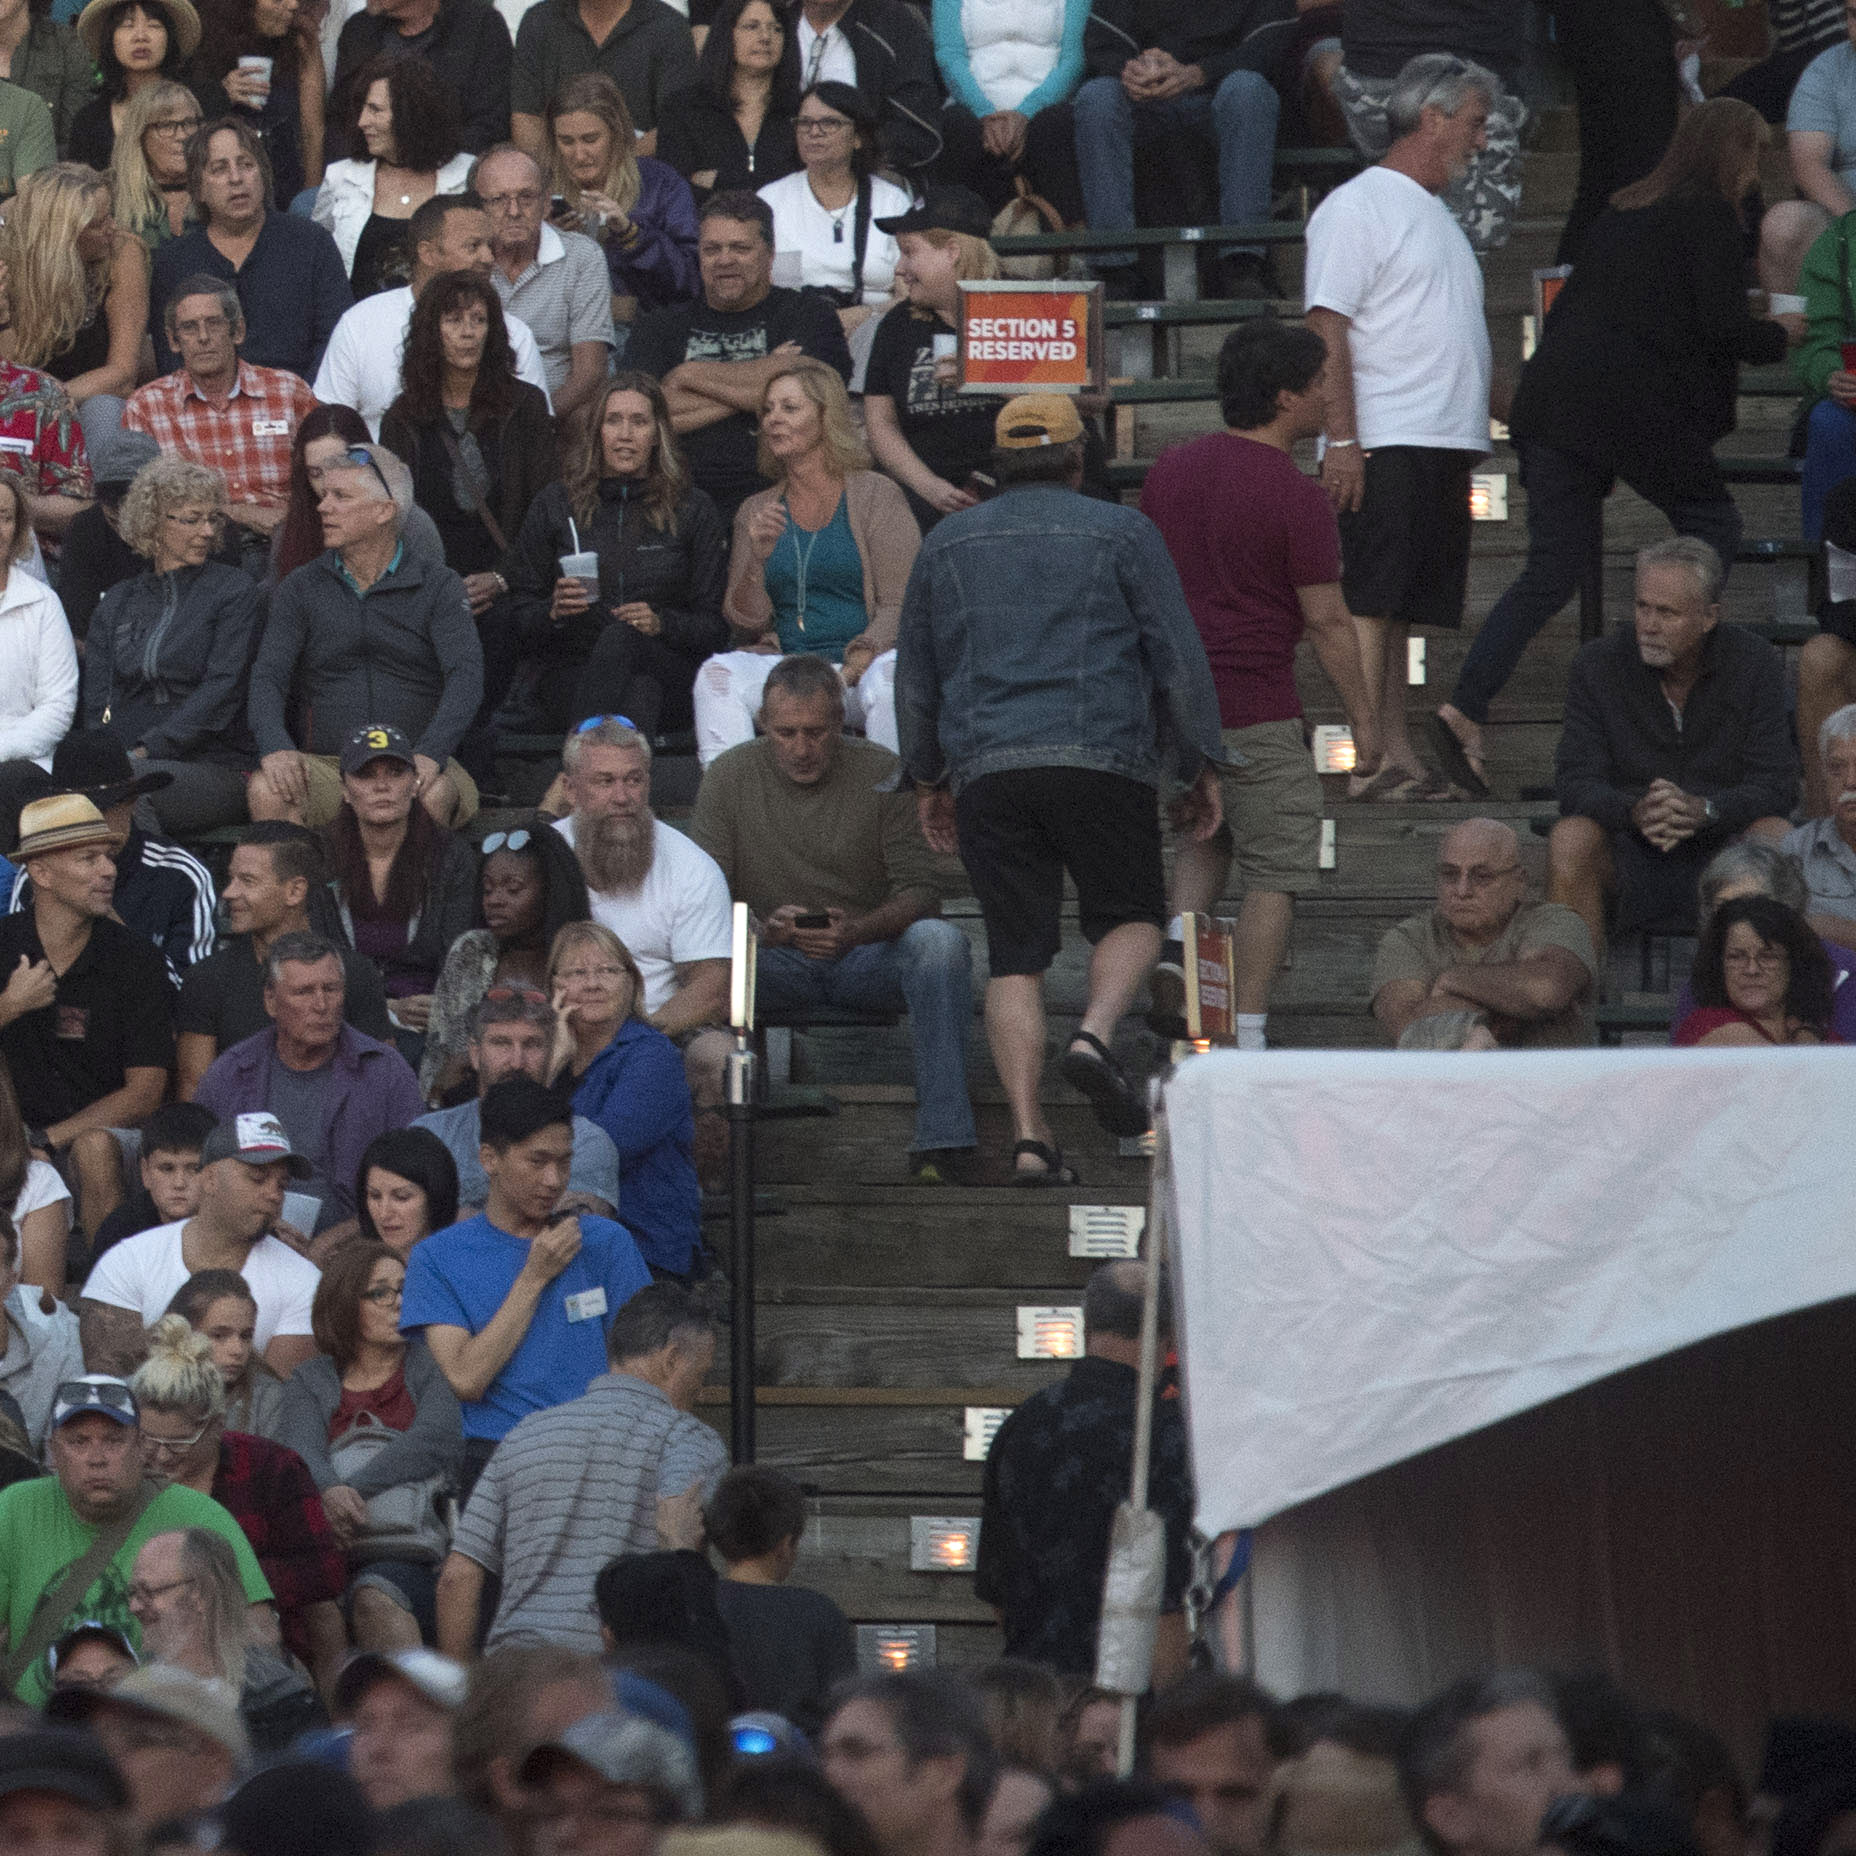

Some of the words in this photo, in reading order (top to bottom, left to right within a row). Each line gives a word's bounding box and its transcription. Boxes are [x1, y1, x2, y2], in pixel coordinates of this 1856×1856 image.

[968, 318, 1058, 339] SECTION
[1062, 318, 1076, 338] 5
[968, 341, 1077, 360] RESERVED
[367, 730, 388, 749] 3
